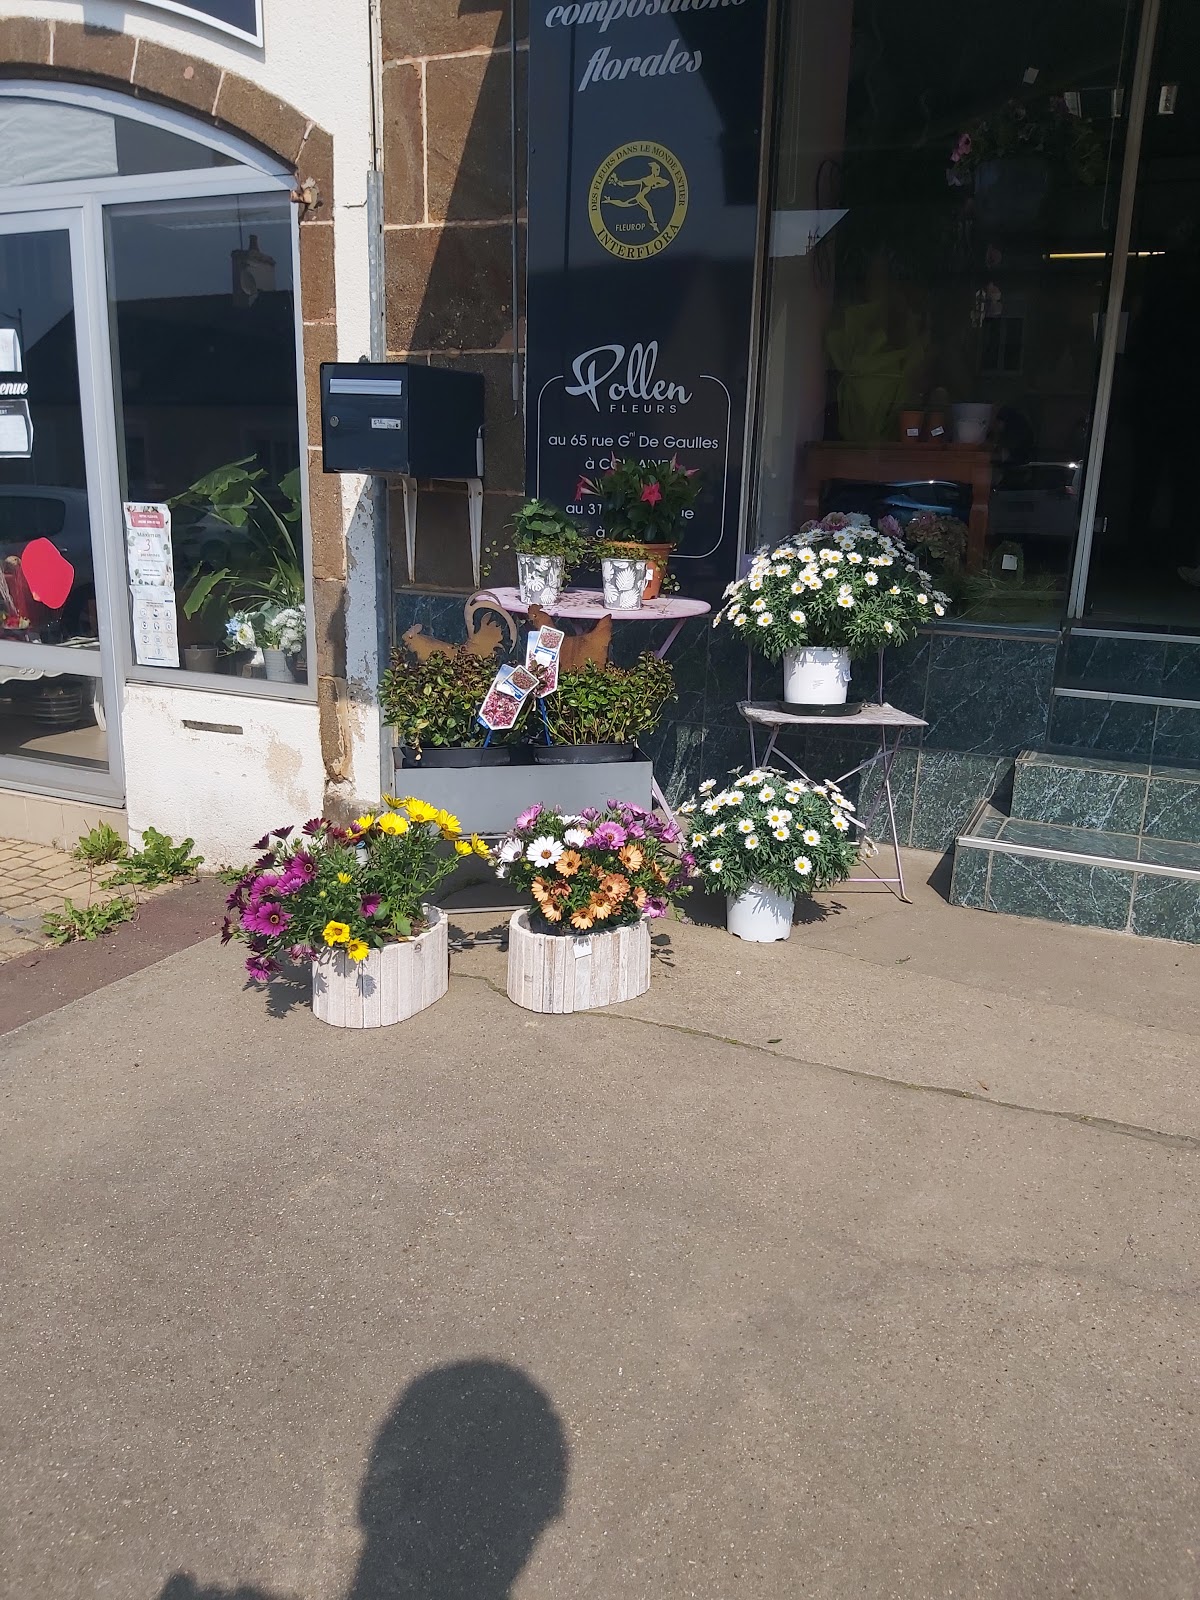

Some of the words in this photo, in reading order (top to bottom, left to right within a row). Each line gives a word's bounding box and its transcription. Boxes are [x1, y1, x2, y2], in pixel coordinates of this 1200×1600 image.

[545, 0, 747, 33] compos
[578, 38, 703, 92] florales
[594, 157, 616, 190] FLEURS
[616, 145, 638, 160] DANS
[640, 144, 651, 152] LE
[651, 147, 677, 171] MONDE
[674, 169, 686, 207] ENTIER
[615, 222, 646, 232] FLEUROP
[596, 223, 680, 258] INTERFLORA
[565, 340, 693, 412] Pollen
[609, 404, 677, 413] FLEURS
[548, 435, 566, 446] au
[570, 434, 588, 447] 65
[591, 436, 614, 447] rue
[639, 435, 659, 448] De
[663, 436, 719, 449] Gaulles
[584, 456, 595, 470] à
[565, 504, 583, 515] au
[595, 525, 605, 538] à
[143, 538, 151, 552] 3
